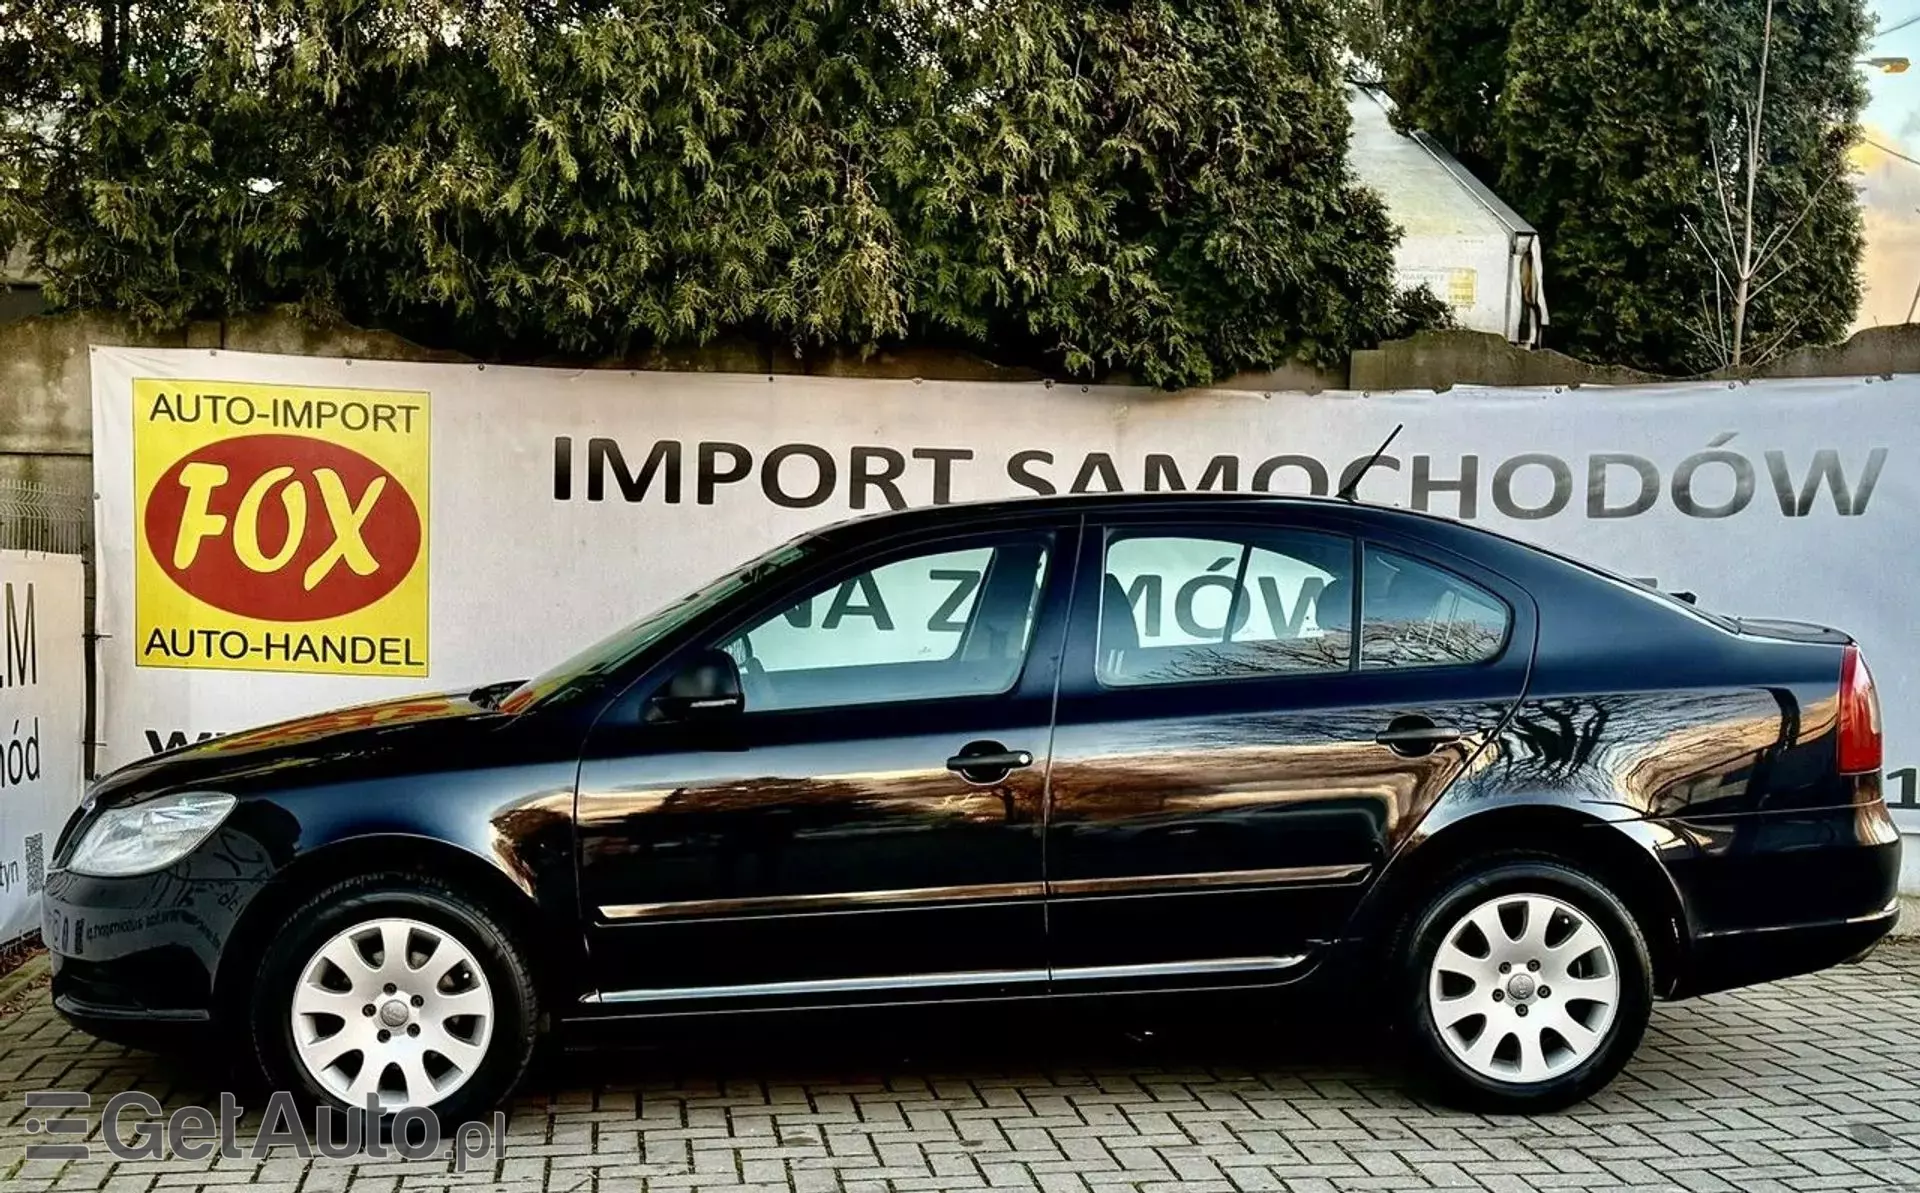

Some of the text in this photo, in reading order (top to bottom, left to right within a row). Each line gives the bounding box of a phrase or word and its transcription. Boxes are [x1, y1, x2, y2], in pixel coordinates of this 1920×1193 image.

[149, 393, 420, 433] AUTO-IMPORT
[553, 432, 1888, 519] IMPORT SAMOCHODÓW
[174, 461, 388, 592] FOX
[144, 628, 425, 666] AUTO-HANDEL
